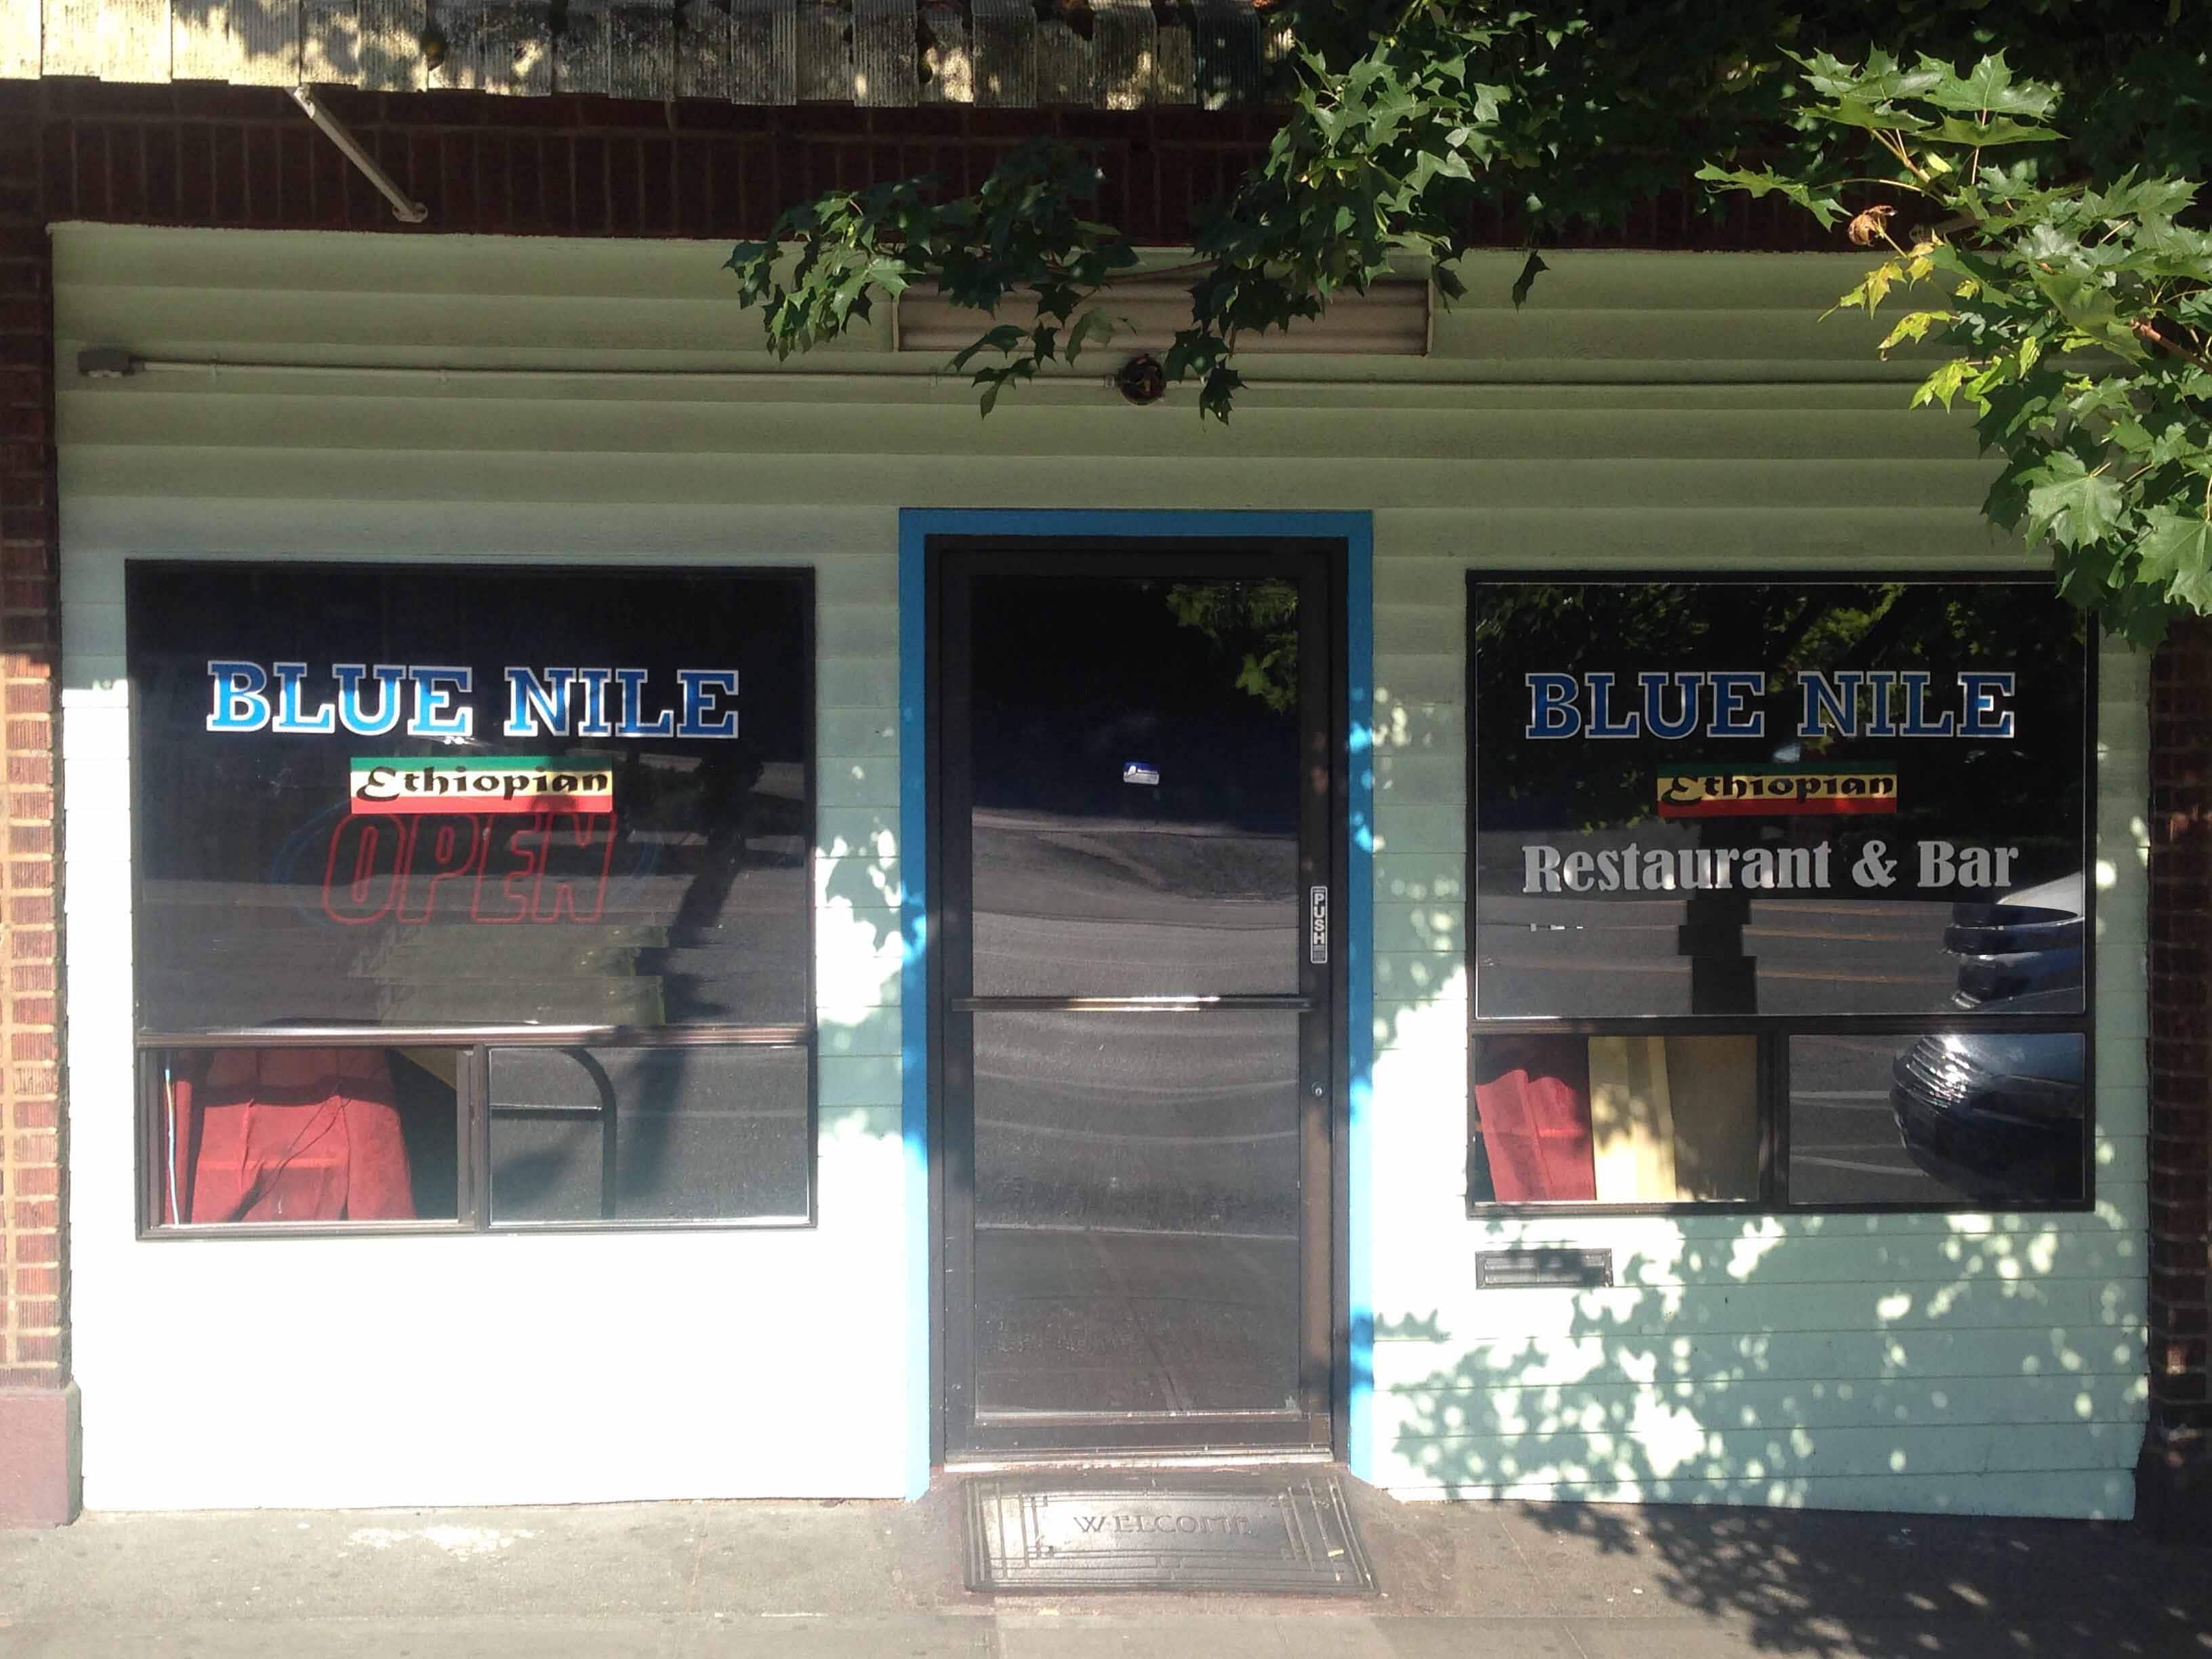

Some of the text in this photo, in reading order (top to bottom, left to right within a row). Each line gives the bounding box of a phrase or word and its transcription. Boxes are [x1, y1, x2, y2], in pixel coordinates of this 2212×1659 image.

[206, 660, 739, 739] BLUE NILE
[1525, 672, 2015, 739] BLUE NILE
[358, 766, 608, 802] Ethiopian
[1666, 774, 1893, 803] Ethiopian
[324, 812, 617, 924] OPEN
[1521, 839, 2020, 893] Restaurant & Bar
[1313, 893, 1325, 945] PUSH
[1073, 1514, 1252, 1535] WELCOME
